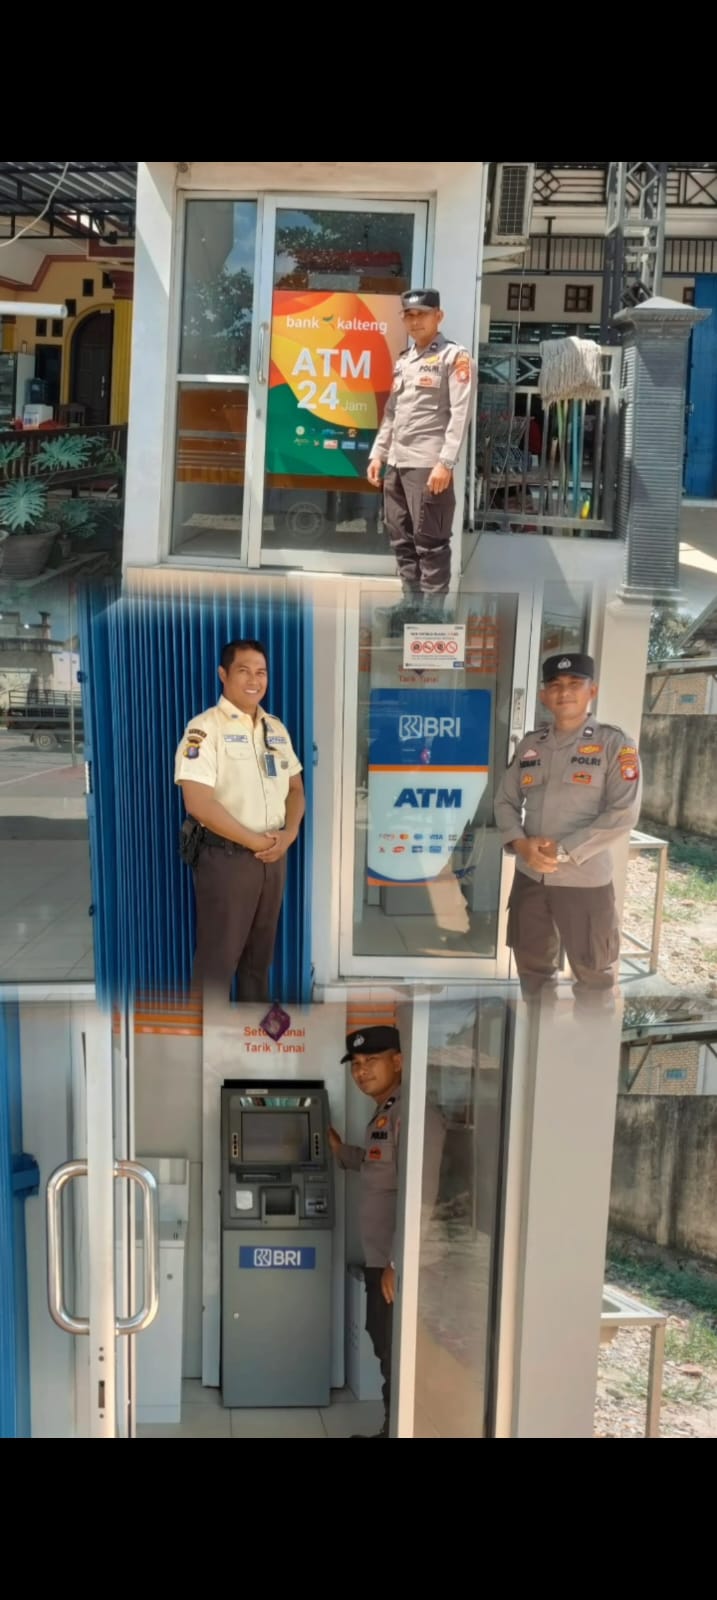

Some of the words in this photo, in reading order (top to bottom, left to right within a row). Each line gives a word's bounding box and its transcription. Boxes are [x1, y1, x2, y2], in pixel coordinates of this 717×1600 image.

[286, 315, 320, 329] bank
[337, 317, 388, 335] kalteng
[291, 347, 371, 379] ATM
[297, 380, 340, 411] 24
[342, 399, 367, 412] Jam
[424, 717, 460, 737] BRI
[571, 756, 601, 766] POLRI
[394, 788, 462, 808] ATM
[244, 1042, 271, 1053] Tarik
[276, 1042, 305, 1053] Tunai
[273, 1250, 301, 1266] BRI
